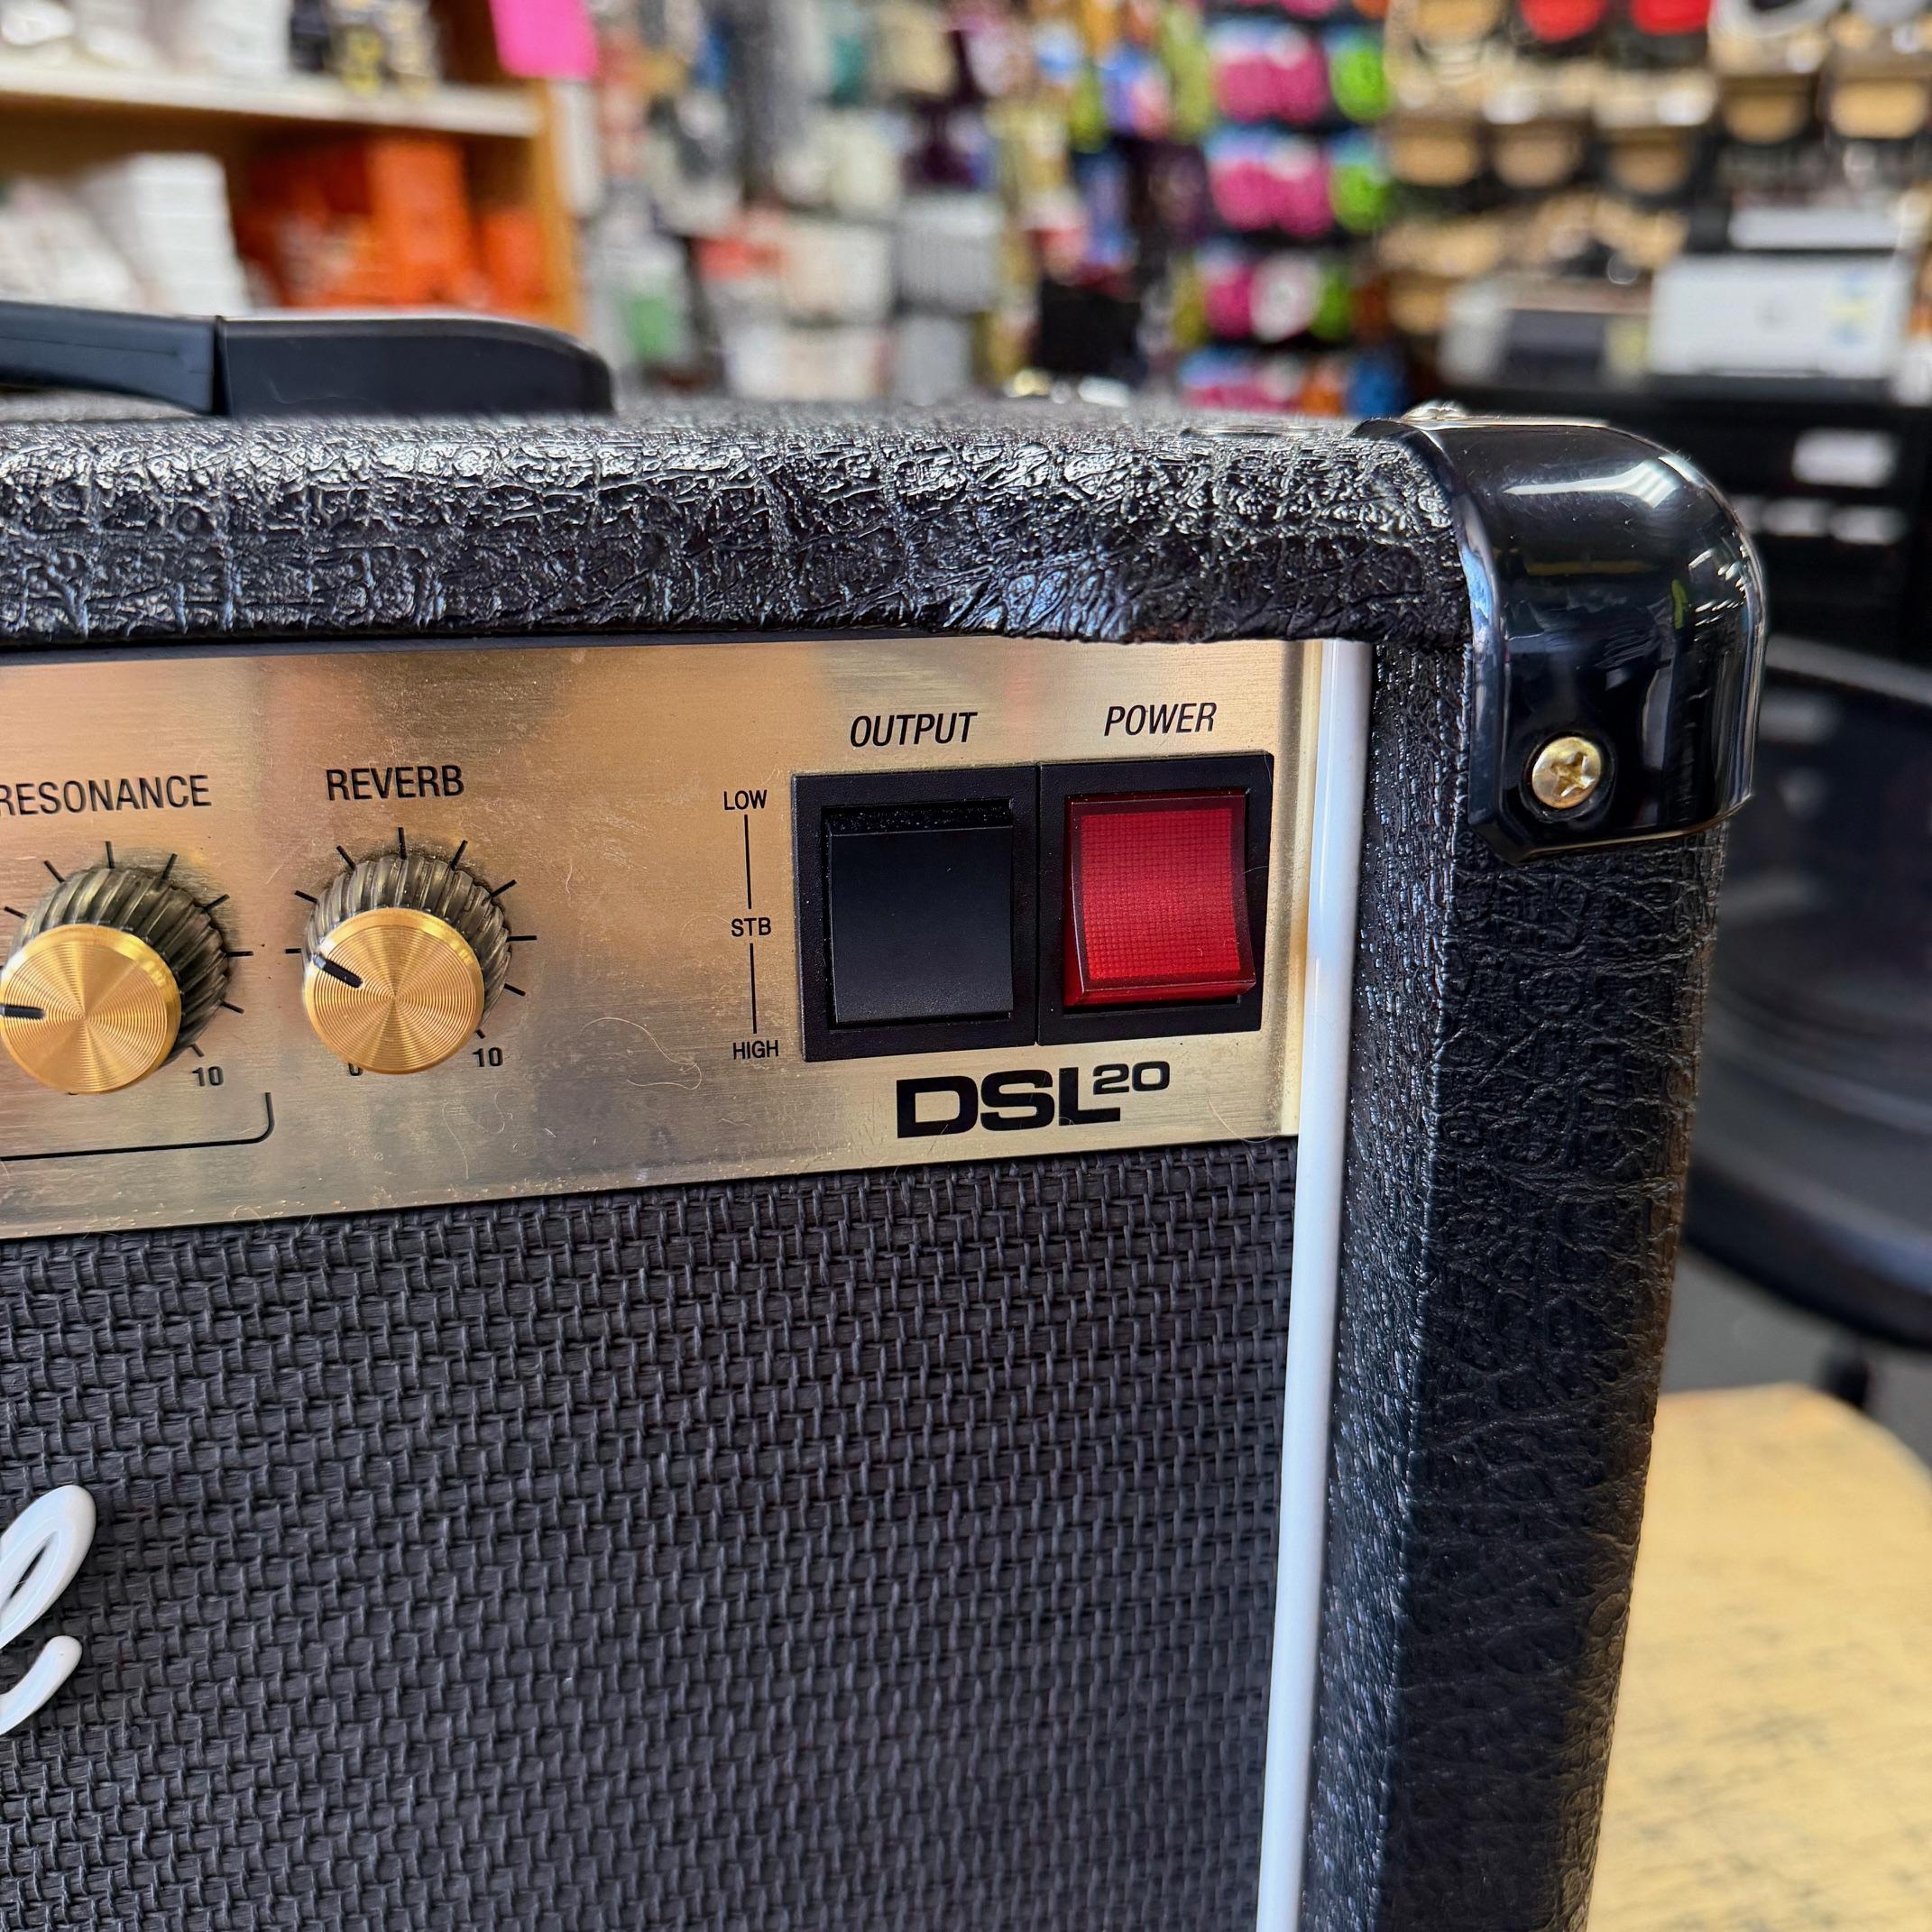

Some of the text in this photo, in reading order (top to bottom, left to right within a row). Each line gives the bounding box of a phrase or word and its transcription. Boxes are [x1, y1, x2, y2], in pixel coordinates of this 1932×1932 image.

[850, 712, 978, 747] OUTPUT
[1104, 703, 1218, 737] POWER
[327, 765, 465, 800] REVERB
[723, 790, 768, 811] LOW
[731, 918, 772, 937] STB
[473, 1047, 504, 1068] 10
[731, 1040, 779, 1061] HIGH
[192, 1066, 225, 1088] 10
